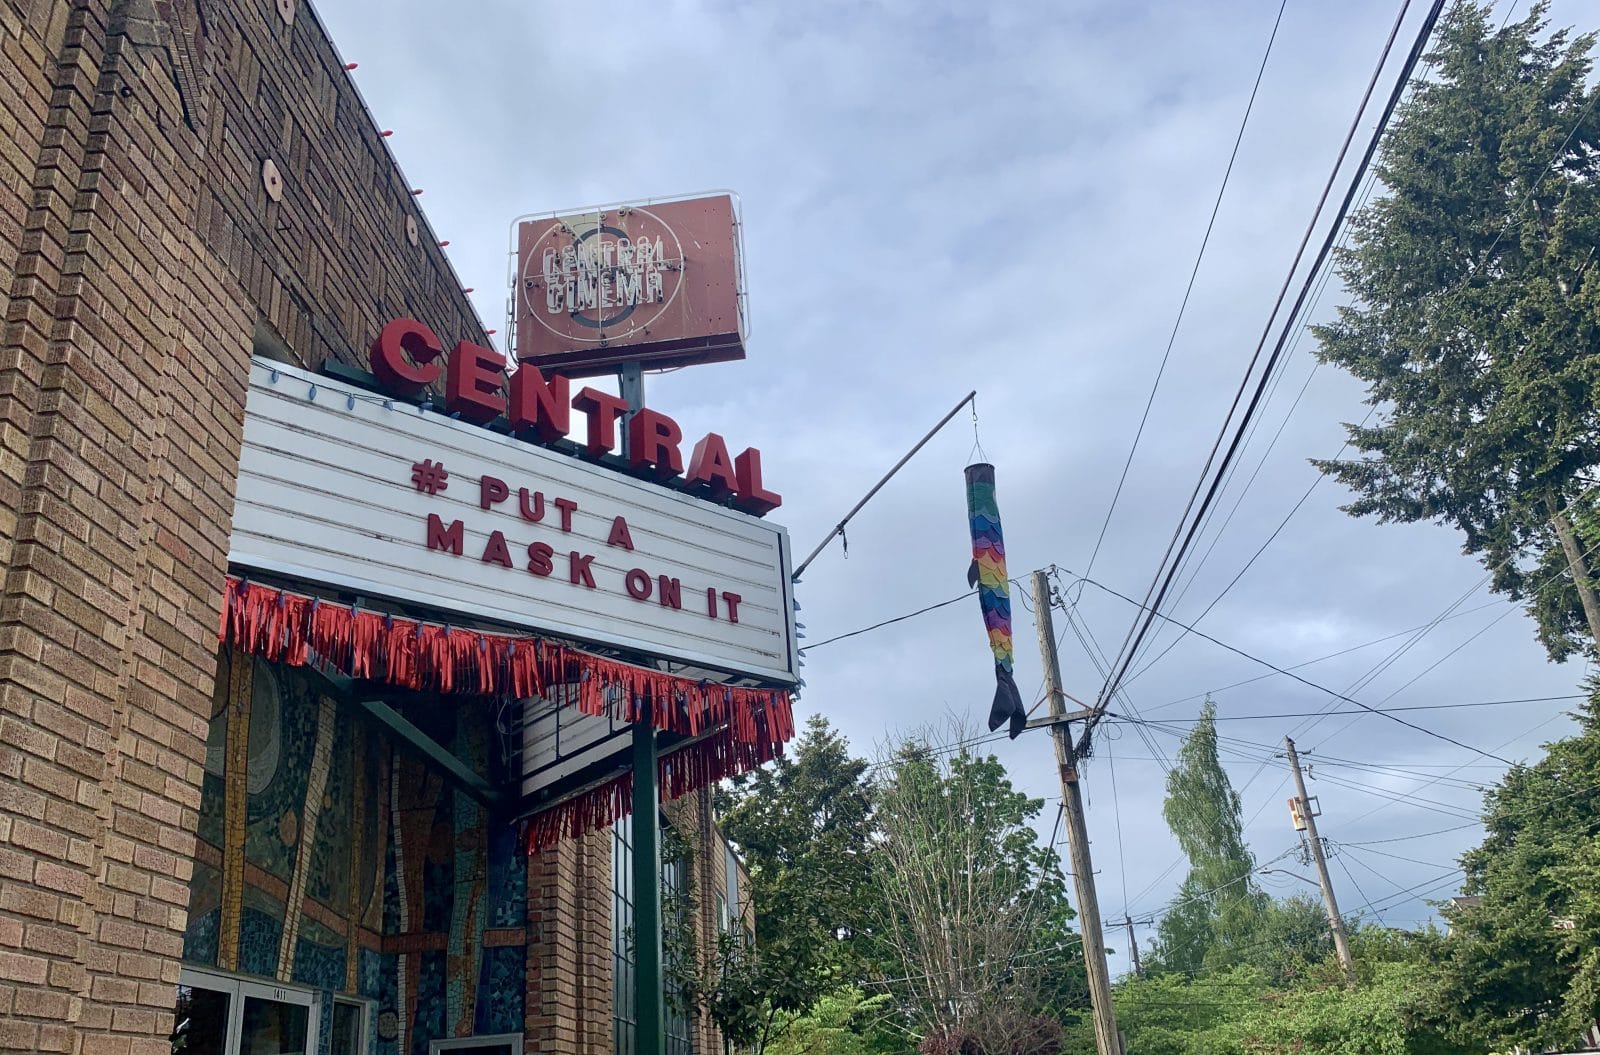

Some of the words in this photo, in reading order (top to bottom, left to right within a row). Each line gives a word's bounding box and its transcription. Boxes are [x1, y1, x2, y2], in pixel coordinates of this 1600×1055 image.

[543, 236, 670, 282] CENTRAL
[545, 268, 664, 314] CINEMA
[370, 318, 782, 517] CENTRAL
[607, 516, 635, 551] A
[427, 513, 597, 588] MASK
[625, 568, 682, 610] ON
[707, 587, 742, 623] IT
